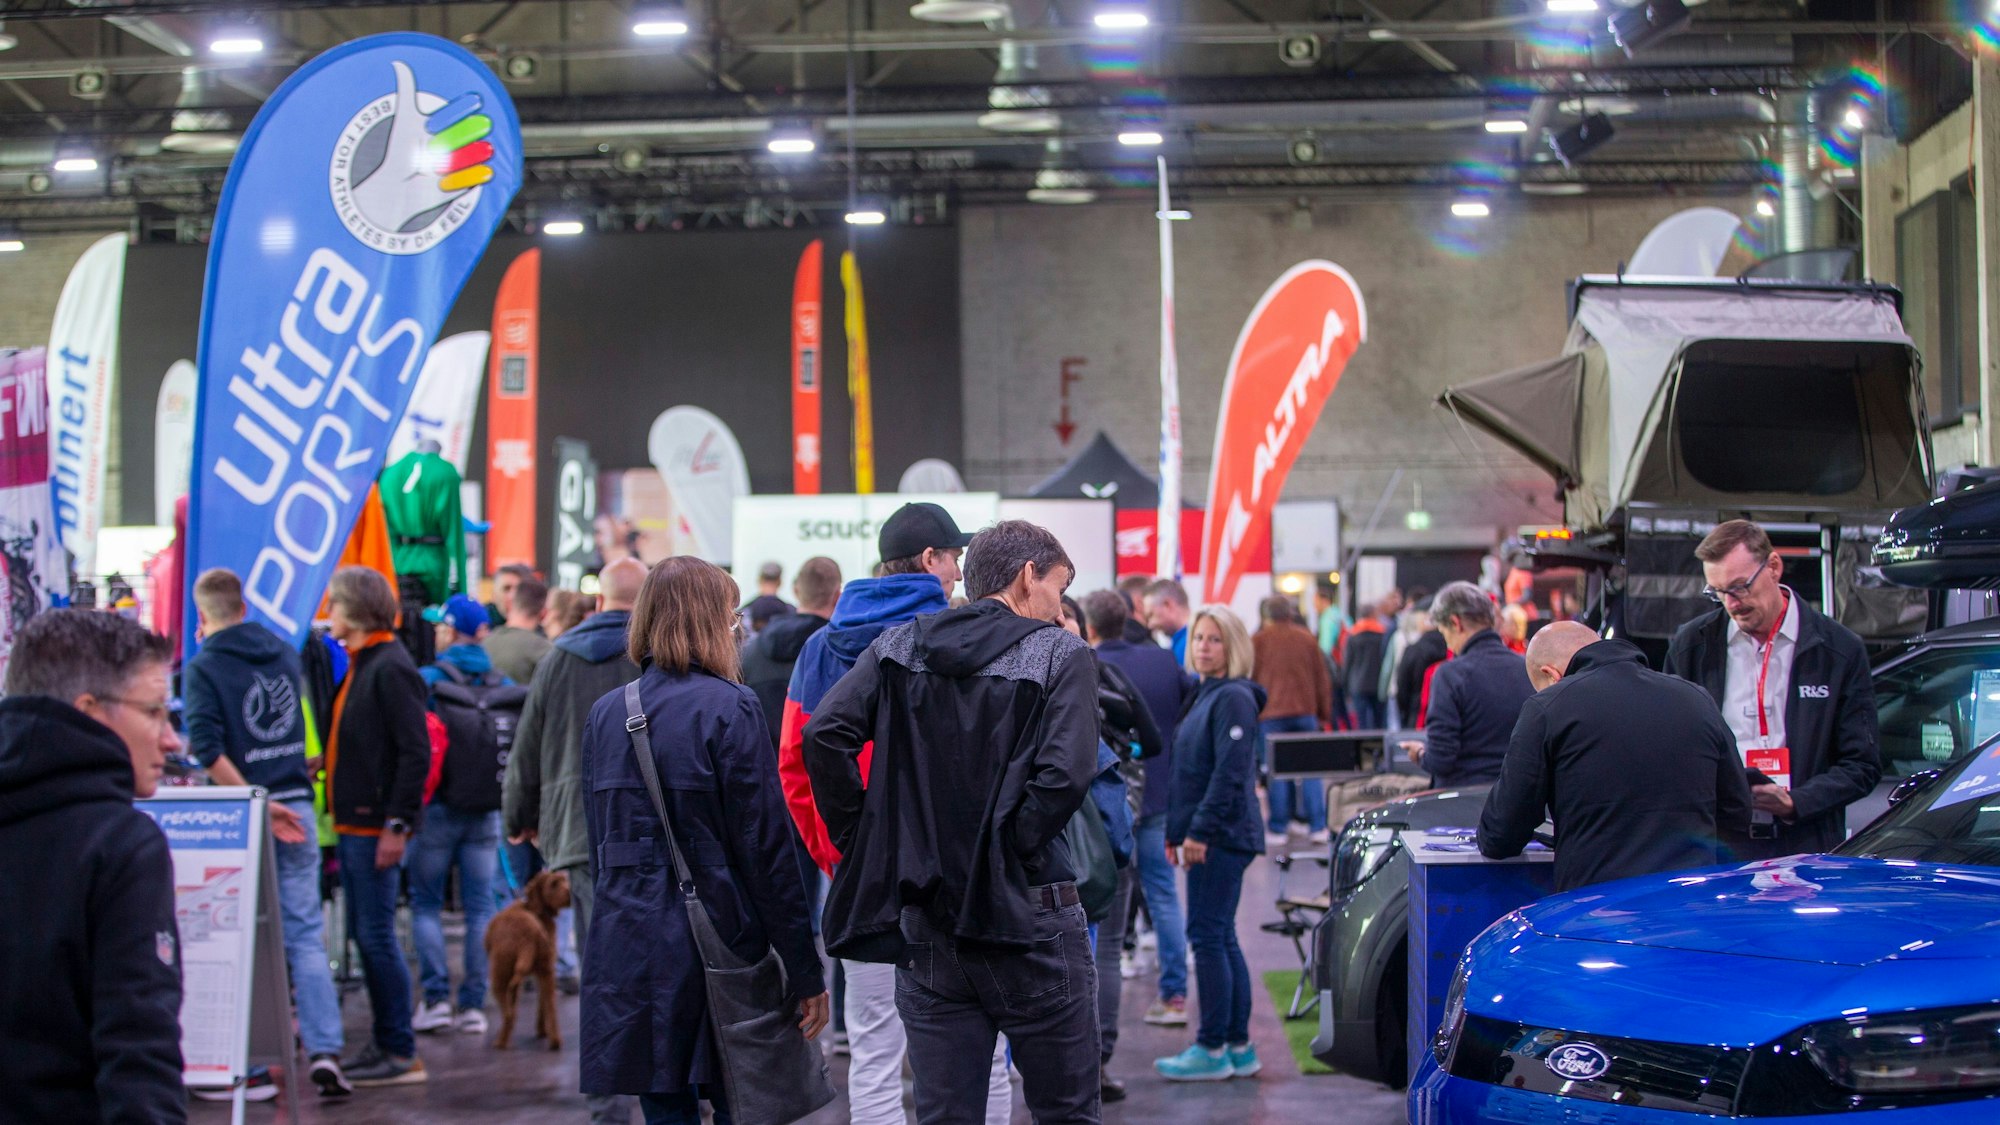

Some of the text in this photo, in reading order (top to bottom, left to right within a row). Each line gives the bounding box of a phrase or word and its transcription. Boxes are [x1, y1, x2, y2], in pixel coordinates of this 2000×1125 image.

[354, 100, 392, 132] BEST
[336, 135, 355, 169] FOR
[334, 176, 384, 246] ATHLETES
[439, 201, 471, 229] FEIL
[387, 237, 408, 250] BY
[214, 247, 368, 505] ultra
[1060, 357, 1088, 398] F
[1251, 308, 1345, 505] ALTRA
[1798, 685, 1830, 699] R&S
[1952, 774, 1987, 792] ab
[1557, 1047, 1599, 1074] Ford
